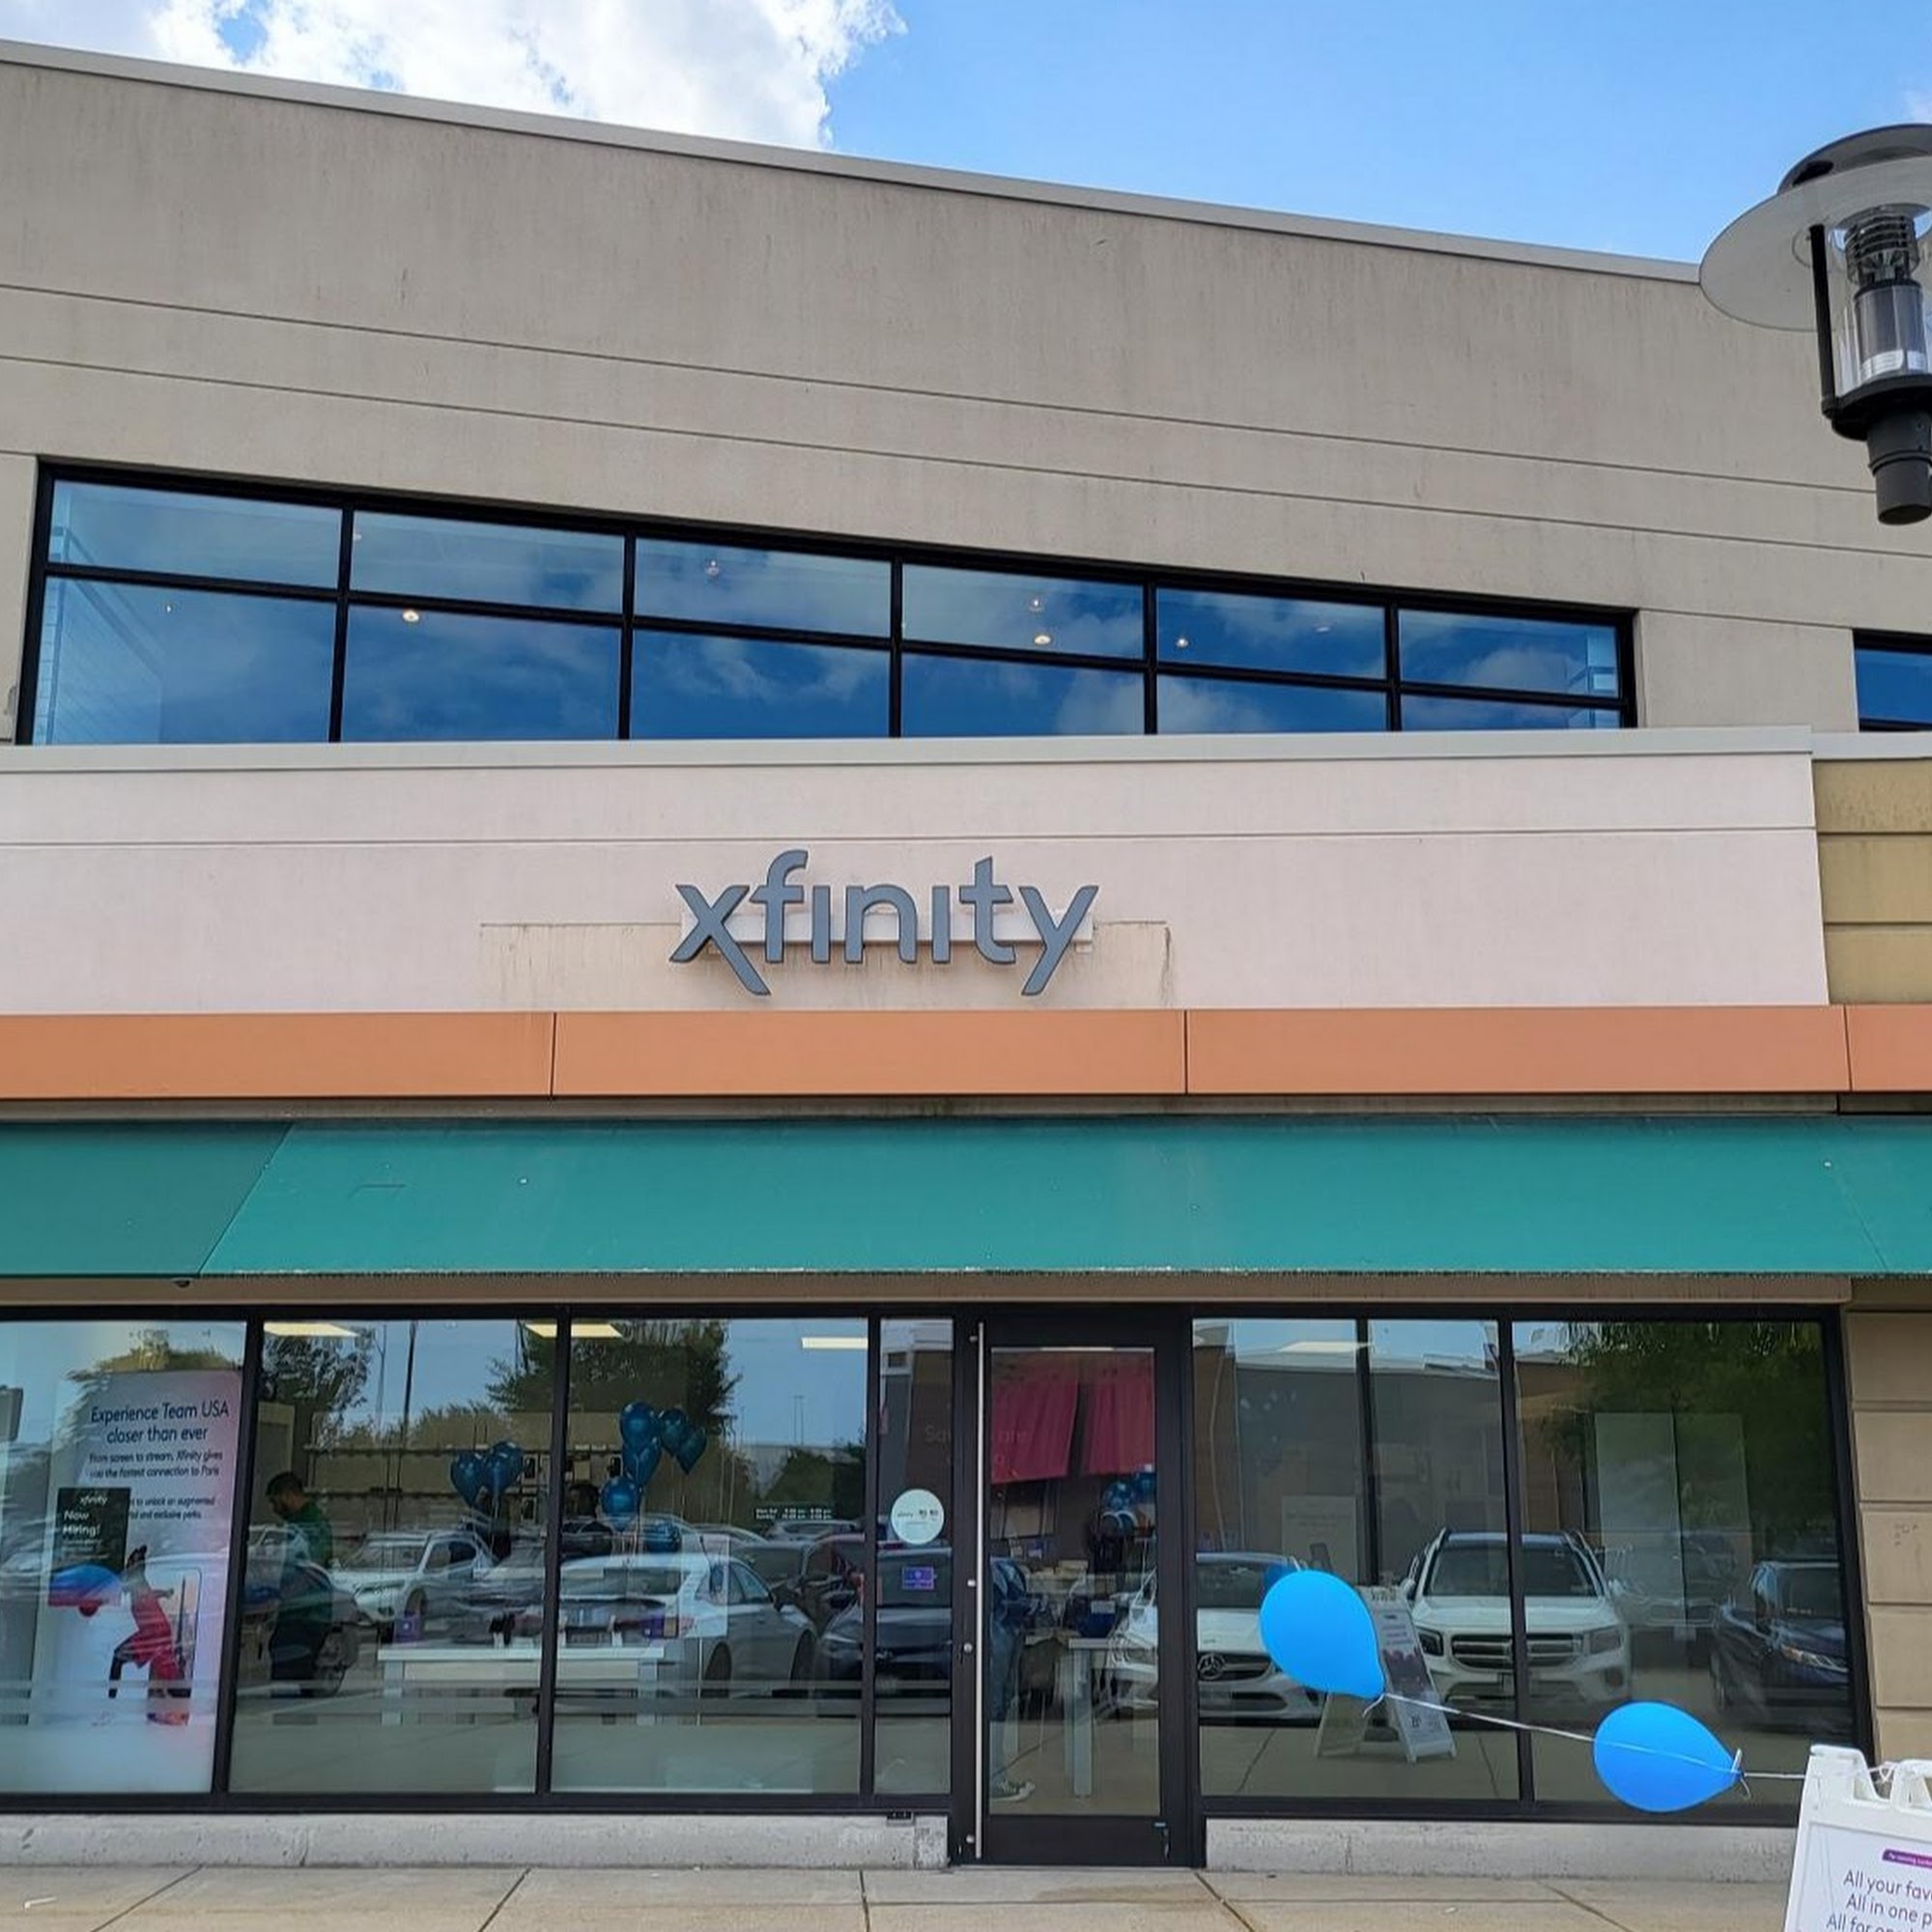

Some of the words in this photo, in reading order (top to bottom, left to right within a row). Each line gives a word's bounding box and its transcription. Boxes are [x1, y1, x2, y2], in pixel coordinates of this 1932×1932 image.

[669, 849, 1099, 996] xfinity
[91, 1405, 158, 1426] Experience
[162, 1403, 197, 1419] Team
[202, 1400, 230, 1417] USA
[107, 1428, 144, 1444] closer
[147, 1426, 177, 1442] than
[181, 1428, 209, 1441] ever
[136, 1452, 144, 1463] to
[147, 1466, 189, 1477] connection
[64, 1510, 90, 1521] Now
[1843, 1870, 1863, 1888] All
[1867, 1878, 1902, 1894] your
[1906, 1880, 1932, 1900] fav
[1846, 1893, 1866, 1913] All
[1870, 1897, 1884, 1915] in
[1889, 1906, 1918, 1922] one
[1827, 1914, 1847, 1931] All
